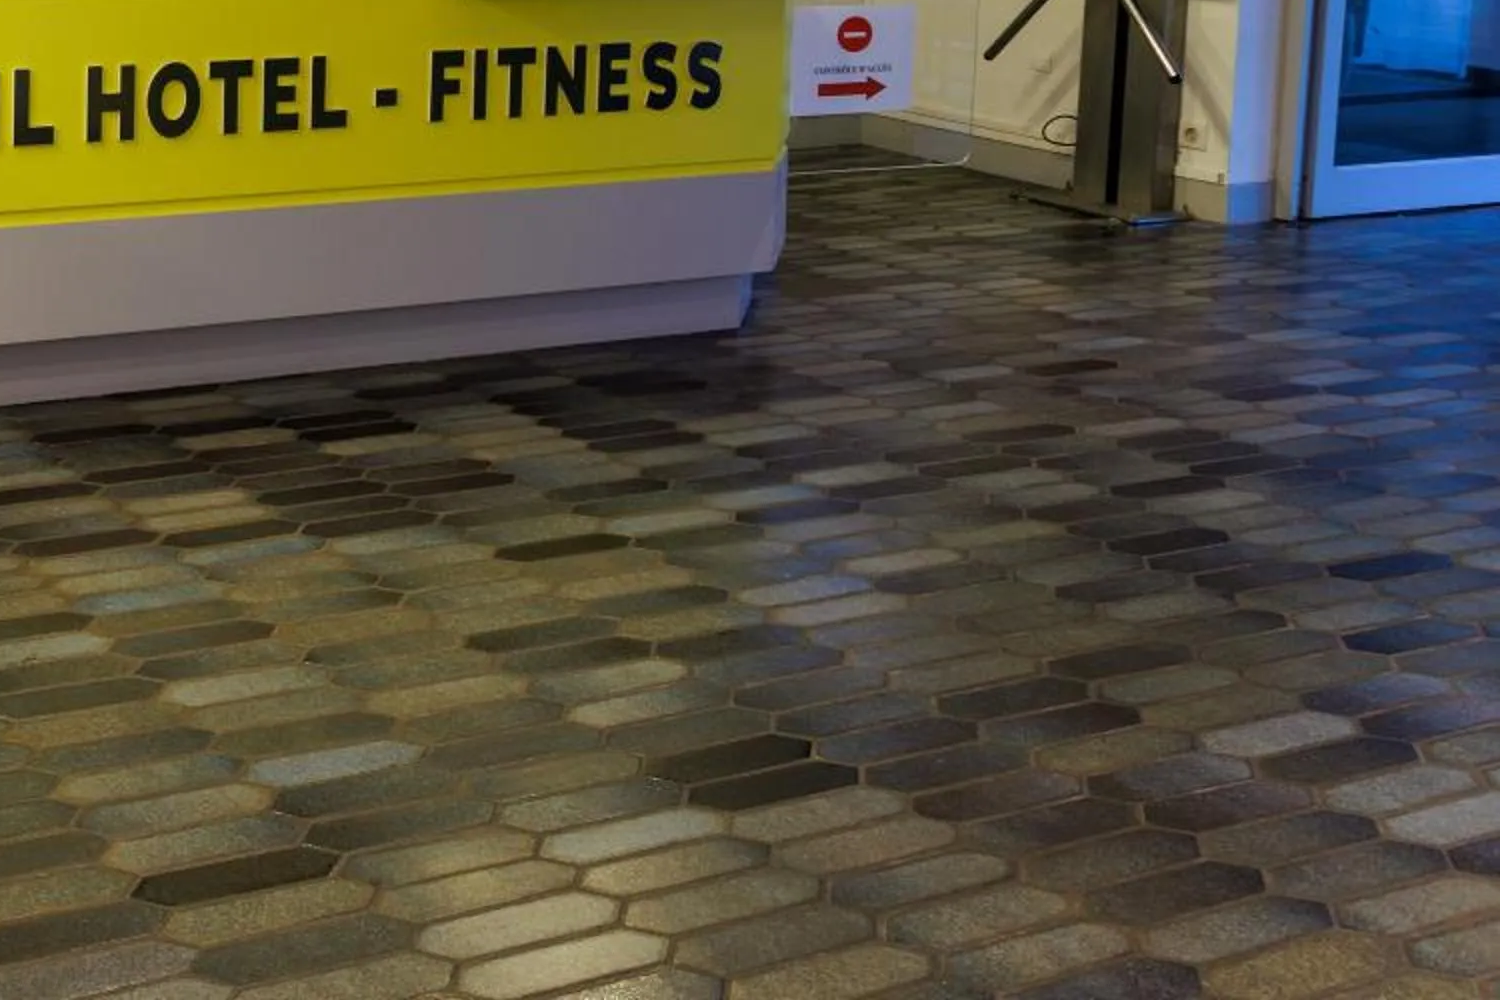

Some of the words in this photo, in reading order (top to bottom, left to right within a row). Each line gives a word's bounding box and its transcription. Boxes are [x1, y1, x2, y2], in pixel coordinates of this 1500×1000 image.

[86, 55, 348, 144] HOTEL
[375, 87, 399, 107] -
[429, 41, 723, 123] FITNESS
